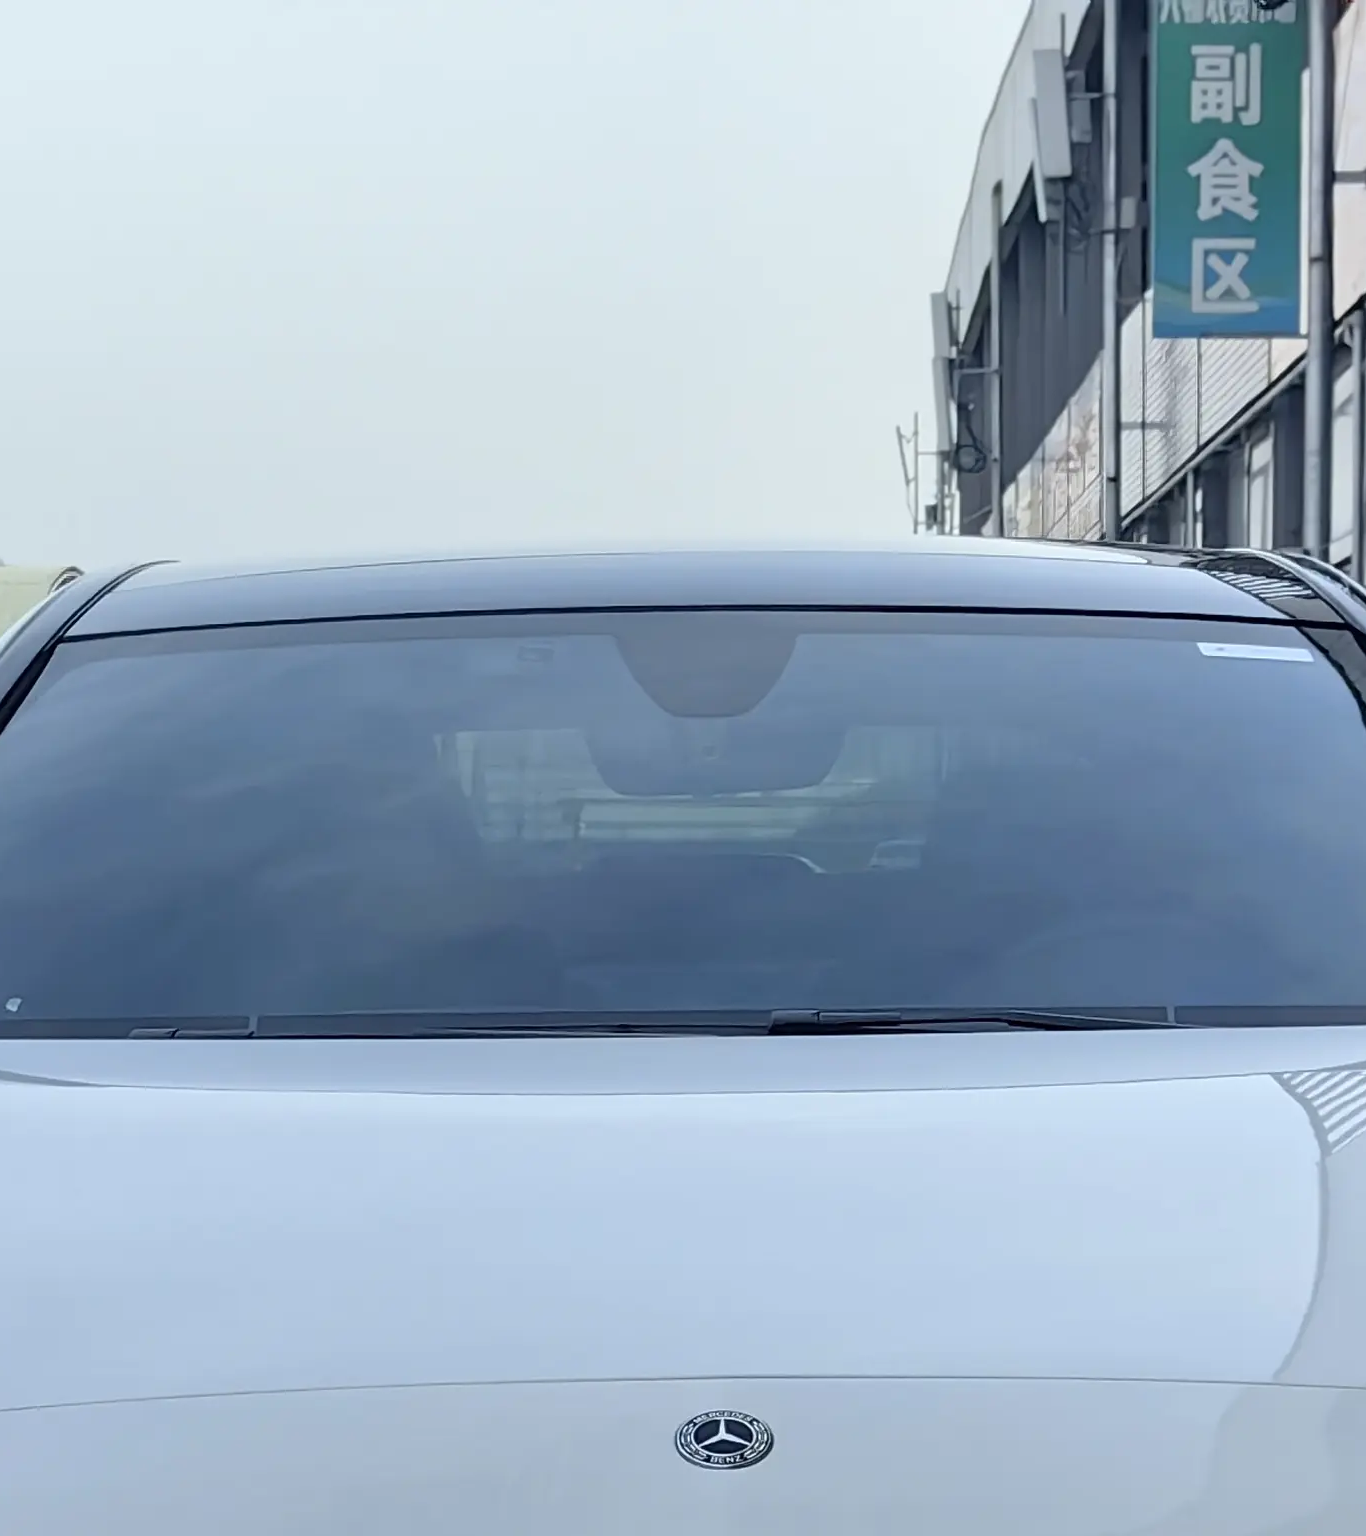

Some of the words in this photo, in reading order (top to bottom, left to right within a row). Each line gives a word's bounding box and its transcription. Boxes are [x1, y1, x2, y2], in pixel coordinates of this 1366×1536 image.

[1187, 42, 1264, 314] 副食区
[692, 1411, 752, 1424] MERCEDES
[709, 1454, 744, 1464] BENZ
